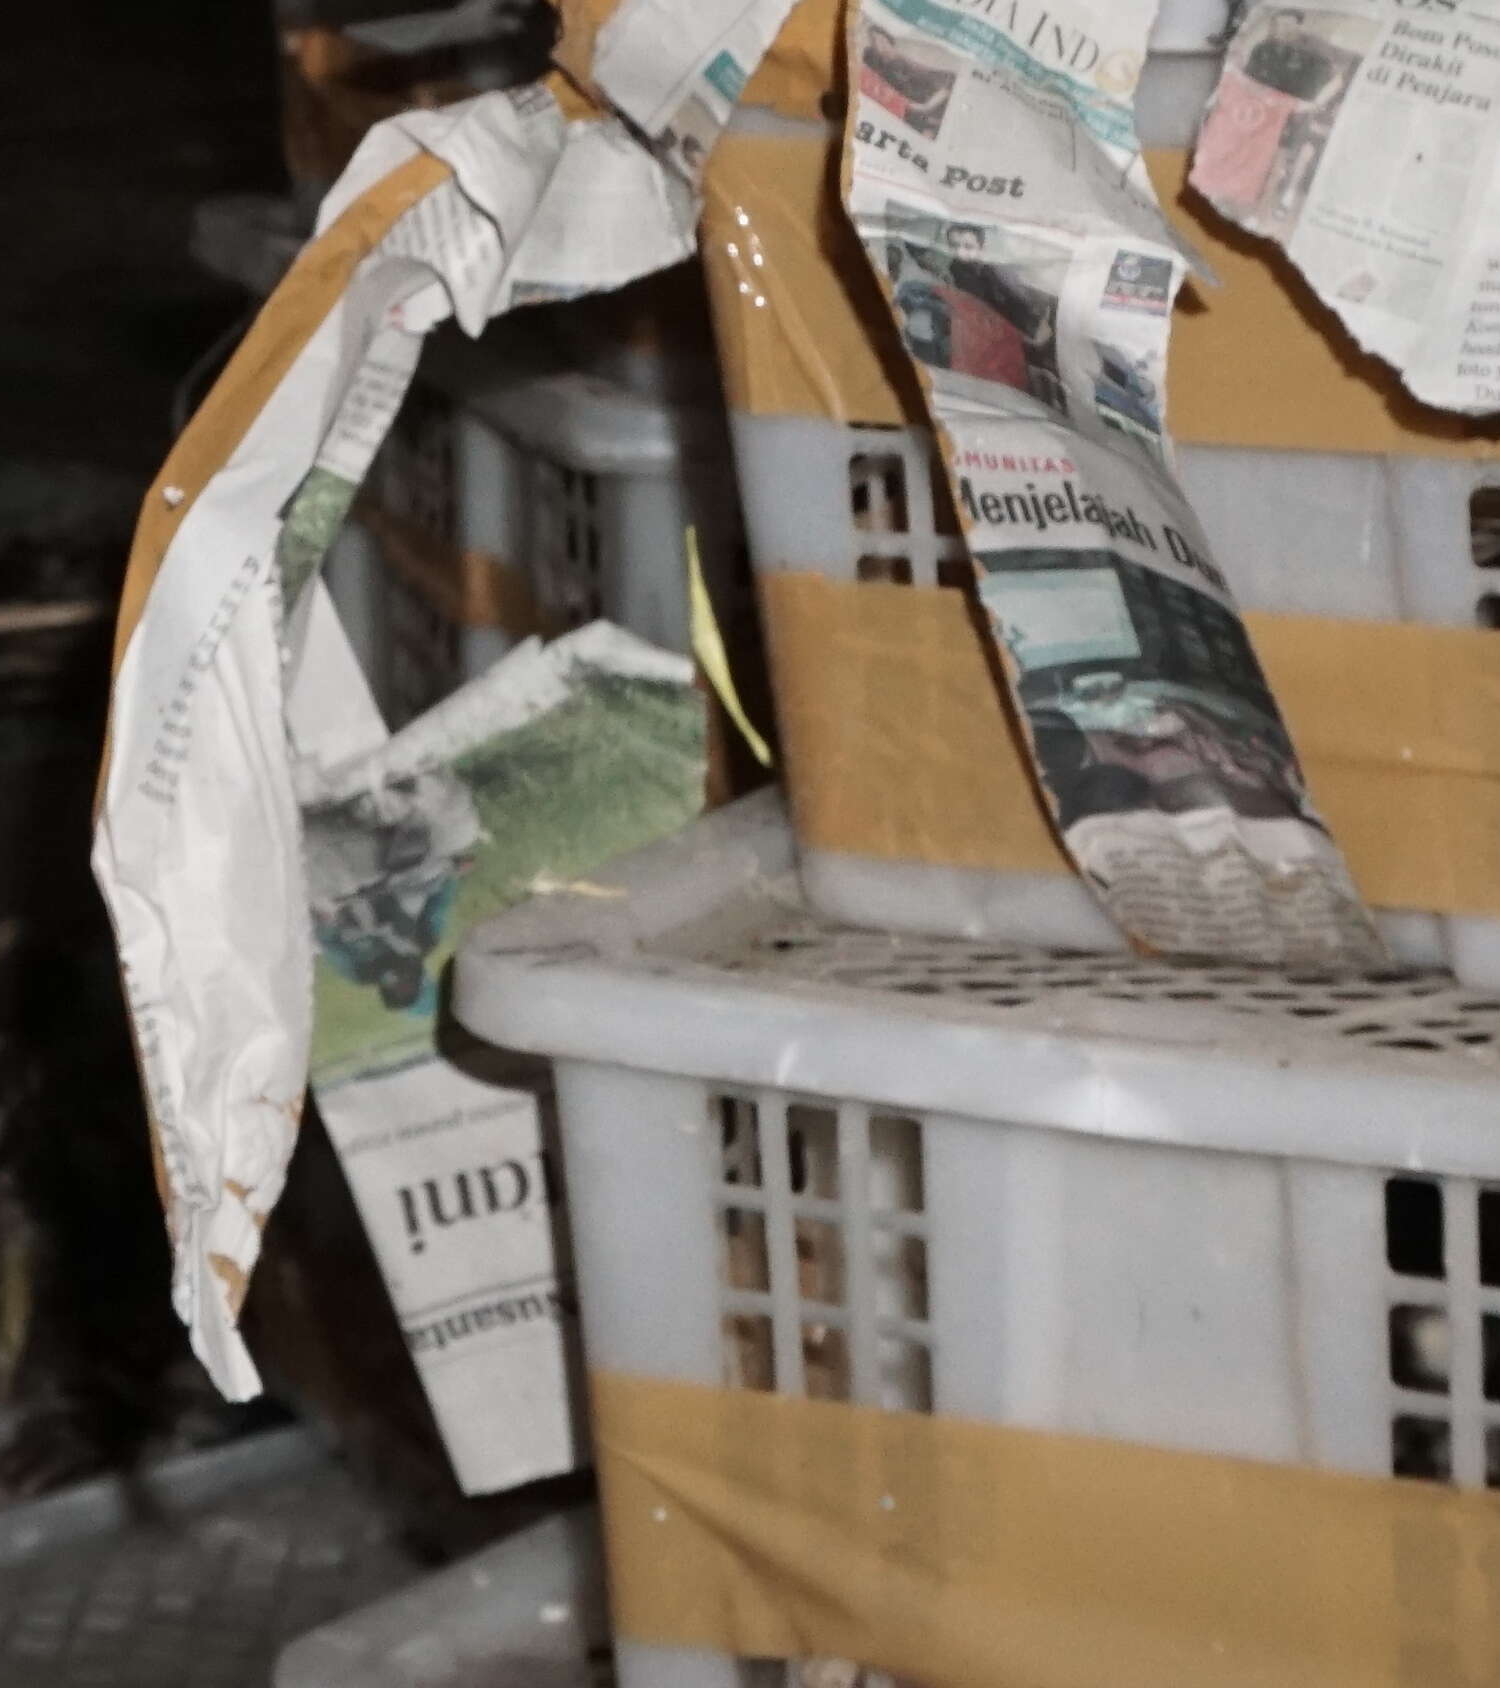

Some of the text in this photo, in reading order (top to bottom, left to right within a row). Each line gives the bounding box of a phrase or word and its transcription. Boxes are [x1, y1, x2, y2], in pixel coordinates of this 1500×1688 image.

[1379, 39, 1464, 77] Dirakit
[1396, 70, 1492, 112] Penjara
[938, 164, 1025, 198] Post
[954, 449, 1077, 475] MUNITAS
